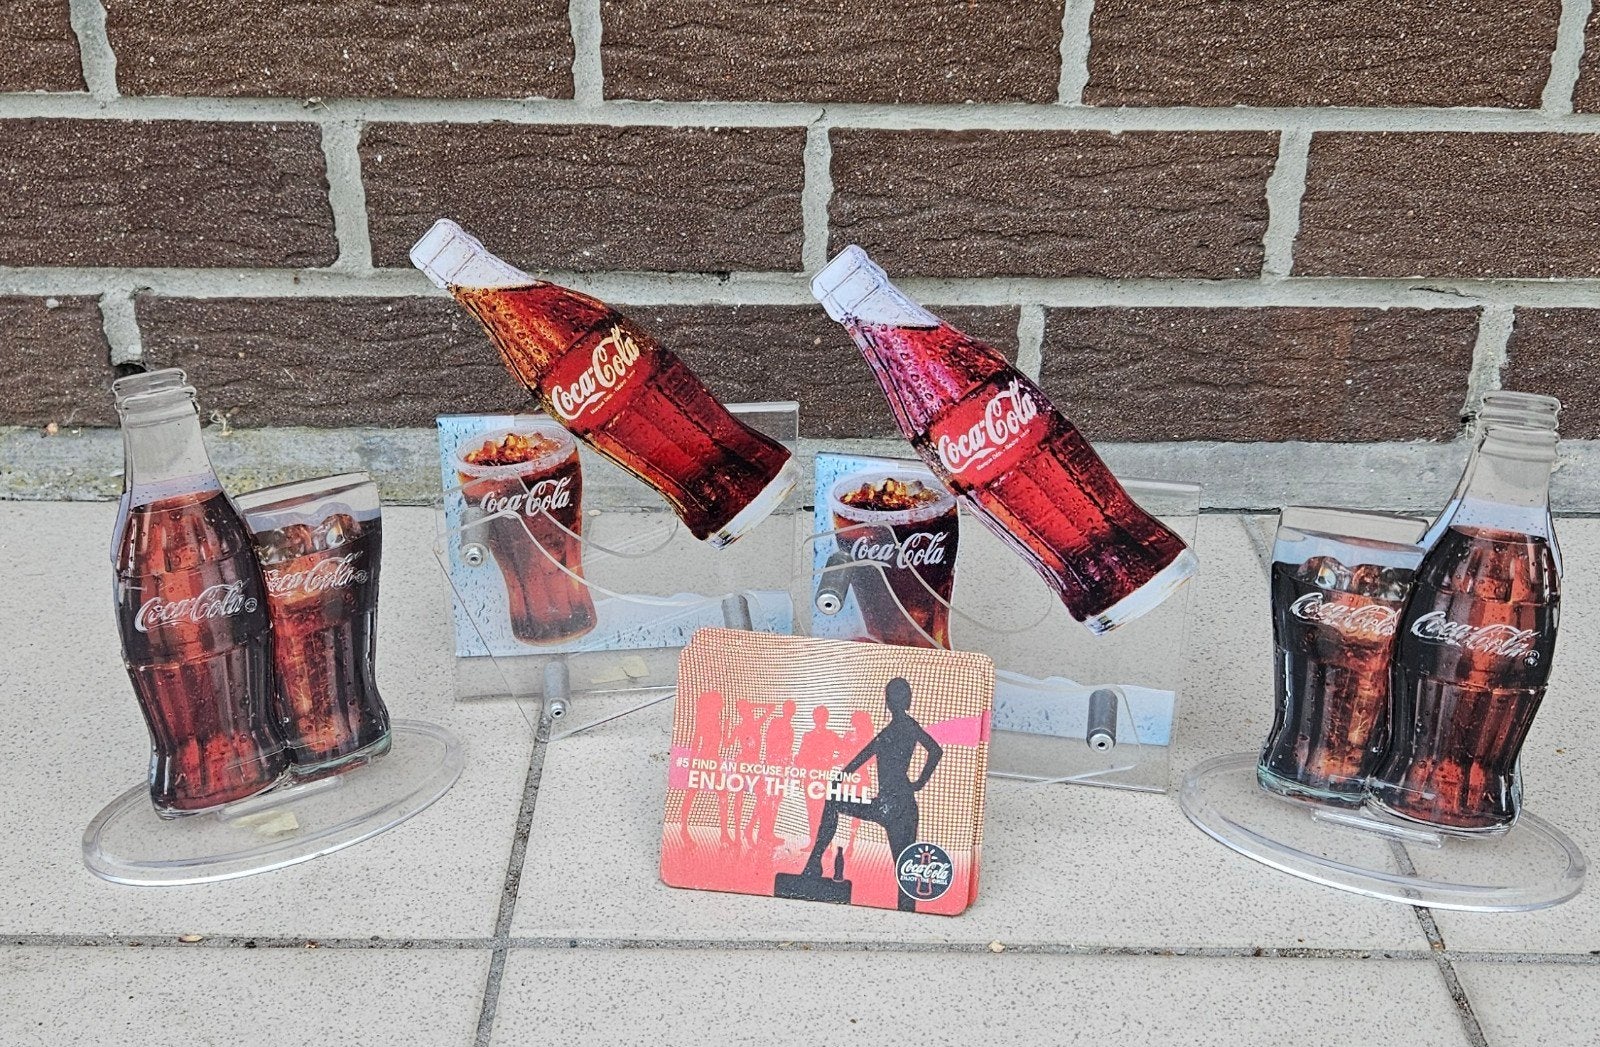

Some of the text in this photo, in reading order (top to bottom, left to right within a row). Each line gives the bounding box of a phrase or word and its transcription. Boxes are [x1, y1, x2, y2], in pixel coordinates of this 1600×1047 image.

[551, 323, 640, 420] Coca-Cola
[937, 376, 1037, 473] Coca-Cola
[675, 757, 689, 768] #5
[691, 758, 717, 770] FIND
[720, 761, 737, 773] AN
[739, 763, 782, 776] EXCUSE
[784, 766, 806, 779] FOR
[688, 770, 872, 805] ENJOY THE CHILL
